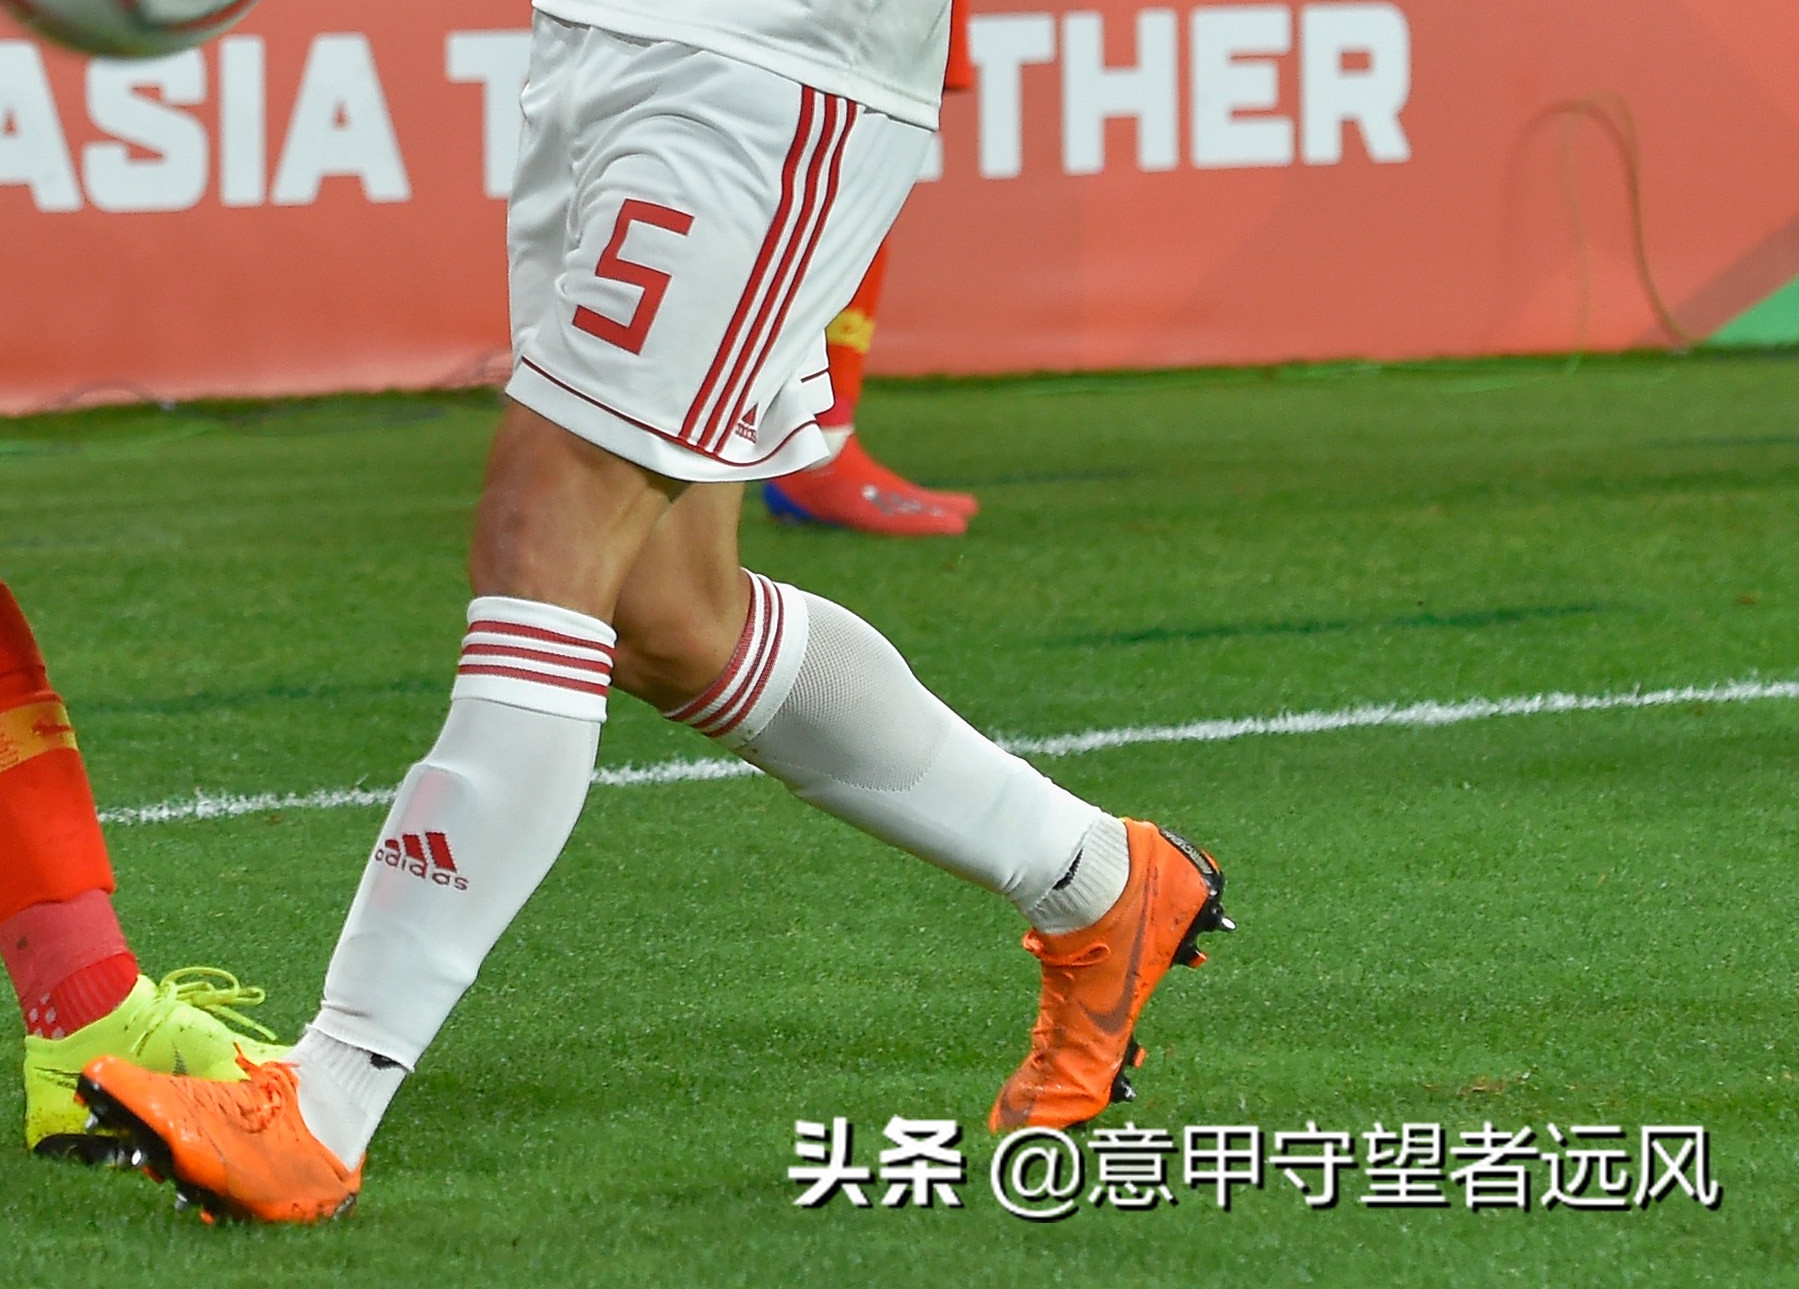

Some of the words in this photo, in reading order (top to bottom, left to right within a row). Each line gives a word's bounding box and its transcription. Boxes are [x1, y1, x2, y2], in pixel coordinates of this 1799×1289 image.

[444, 0, 1412, 200] TTHER
[572, 198, 695, 356] 5
[375, 848, 468, 890] adidas
